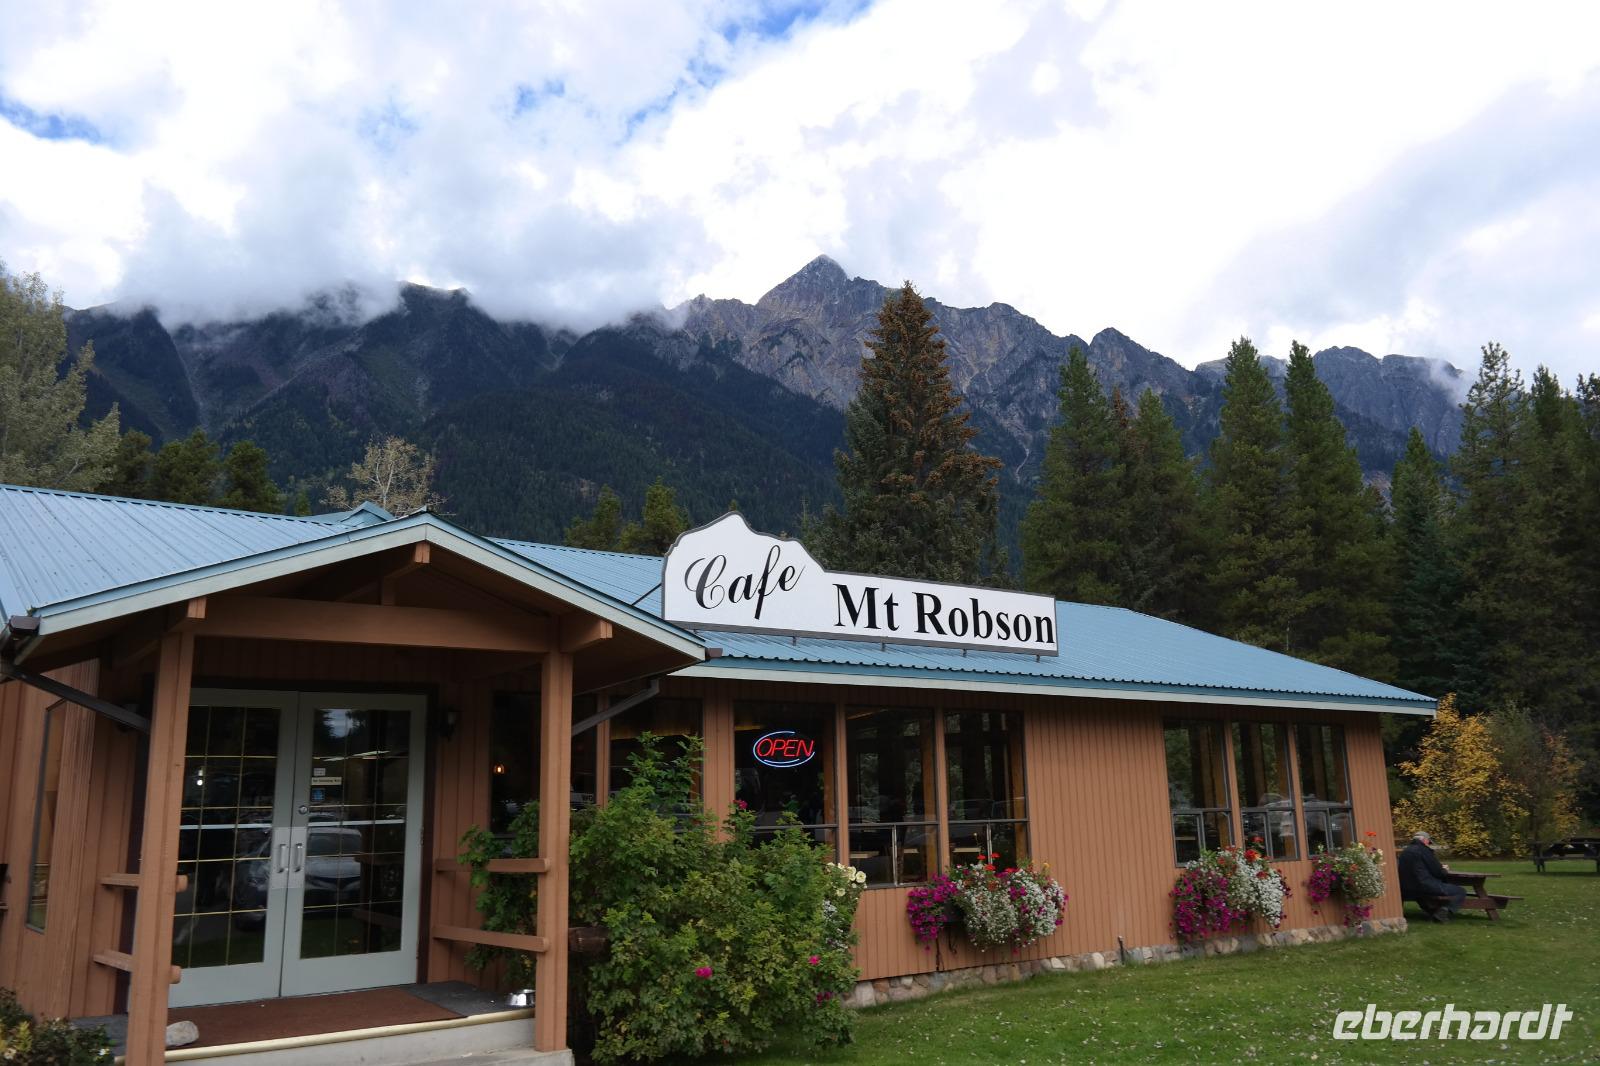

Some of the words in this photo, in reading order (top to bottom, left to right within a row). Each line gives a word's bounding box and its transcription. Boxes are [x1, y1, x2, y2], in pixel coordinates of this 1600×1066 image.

[684, 545, 806, 620] Cafe
[832, 583, 900, 632] Mt
[912, 591, 1055, 644] Robson
[756, 738, 814, 757] OPEN
